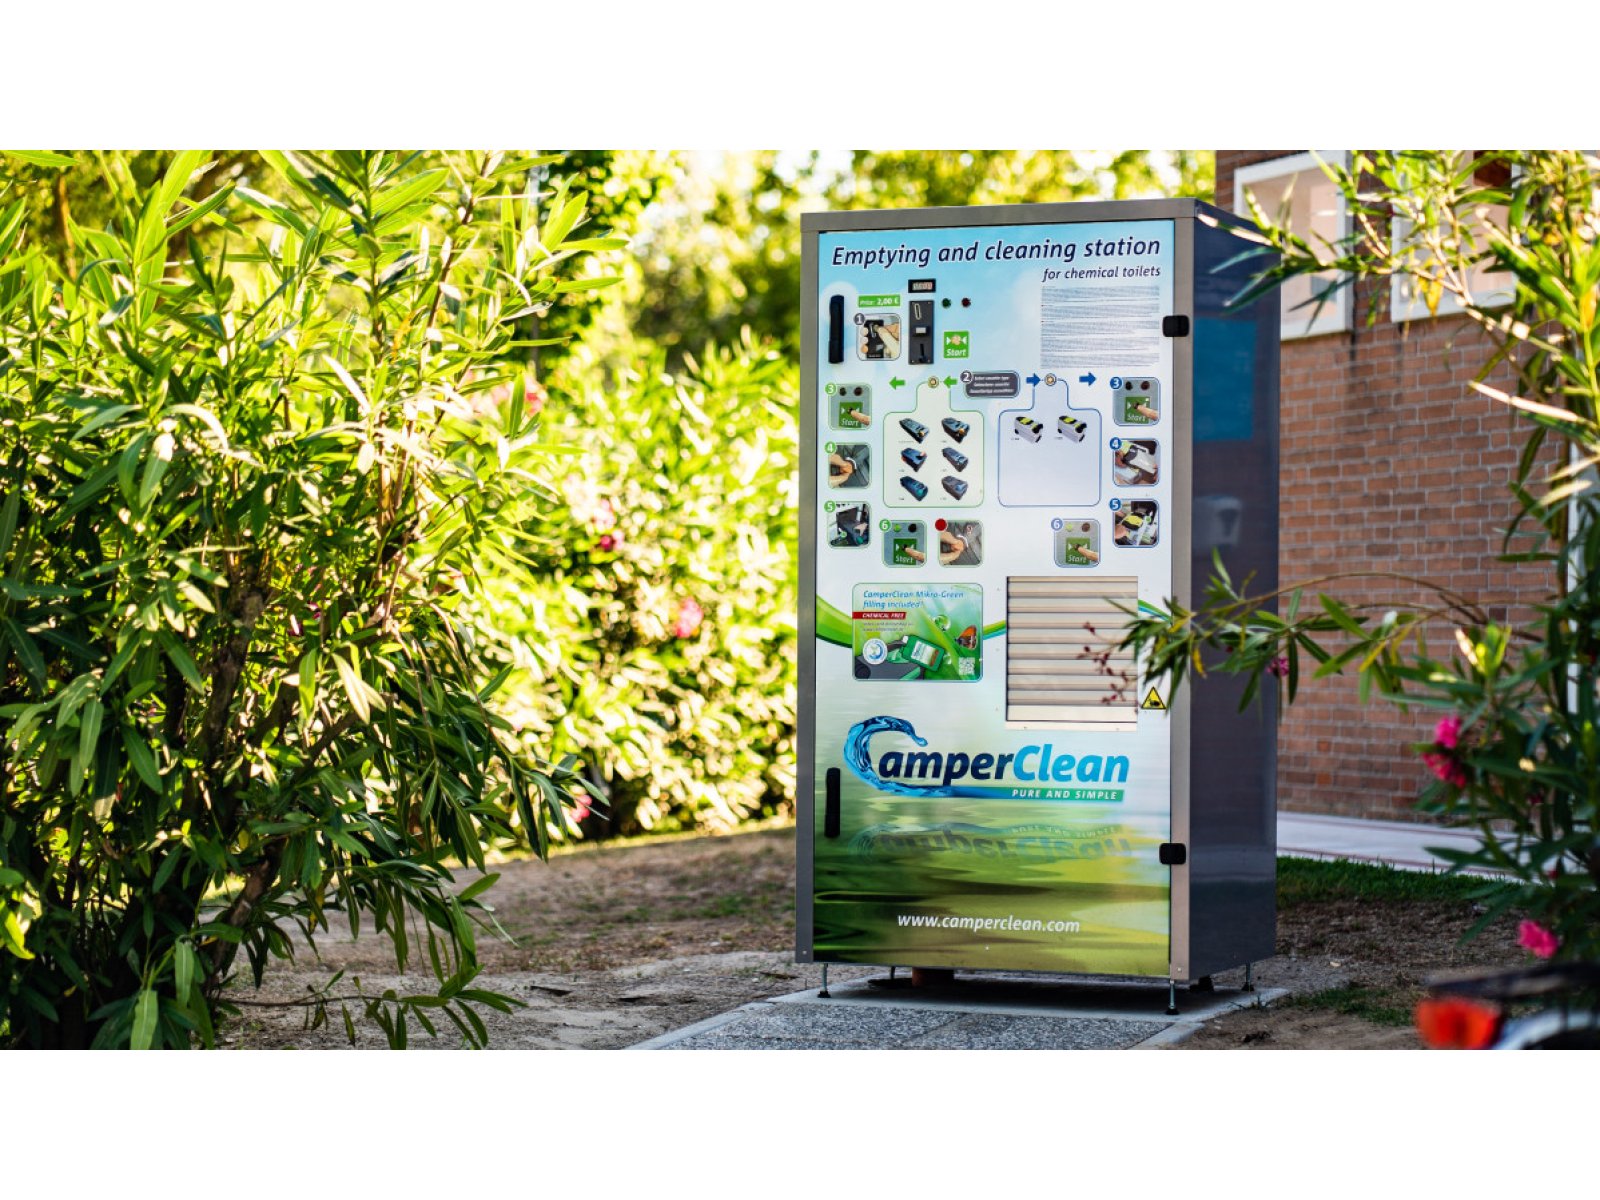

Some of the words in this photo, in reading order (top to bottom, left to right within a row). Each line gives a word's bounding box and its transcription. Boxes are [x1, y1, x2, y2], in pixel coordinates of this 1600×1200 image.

[832, 244, 931, 269] Emptying
[938, 241, 979, 262] and
[985, 239, 1077, 263] cleaning
[1083, 236, 1161, 258] station
[1041, 268, 1062, 283] for
[1064, 266, 1119, 279] chemical
[1122, 265, 1162, 278] toilets
[946, 348, 967, 357] Start
[962, 372, 971, 382] 2
[863, 590, 914, 600] CamperClean
[862, 600, 885, 610] filling
[1011, 788, 1041, 798] PURE
[1046, 789, 1071, 799] AND
[1075, 790, 1118, 800] SIMPLE
[897, 915, 1080, 933] www.camperclean.com
